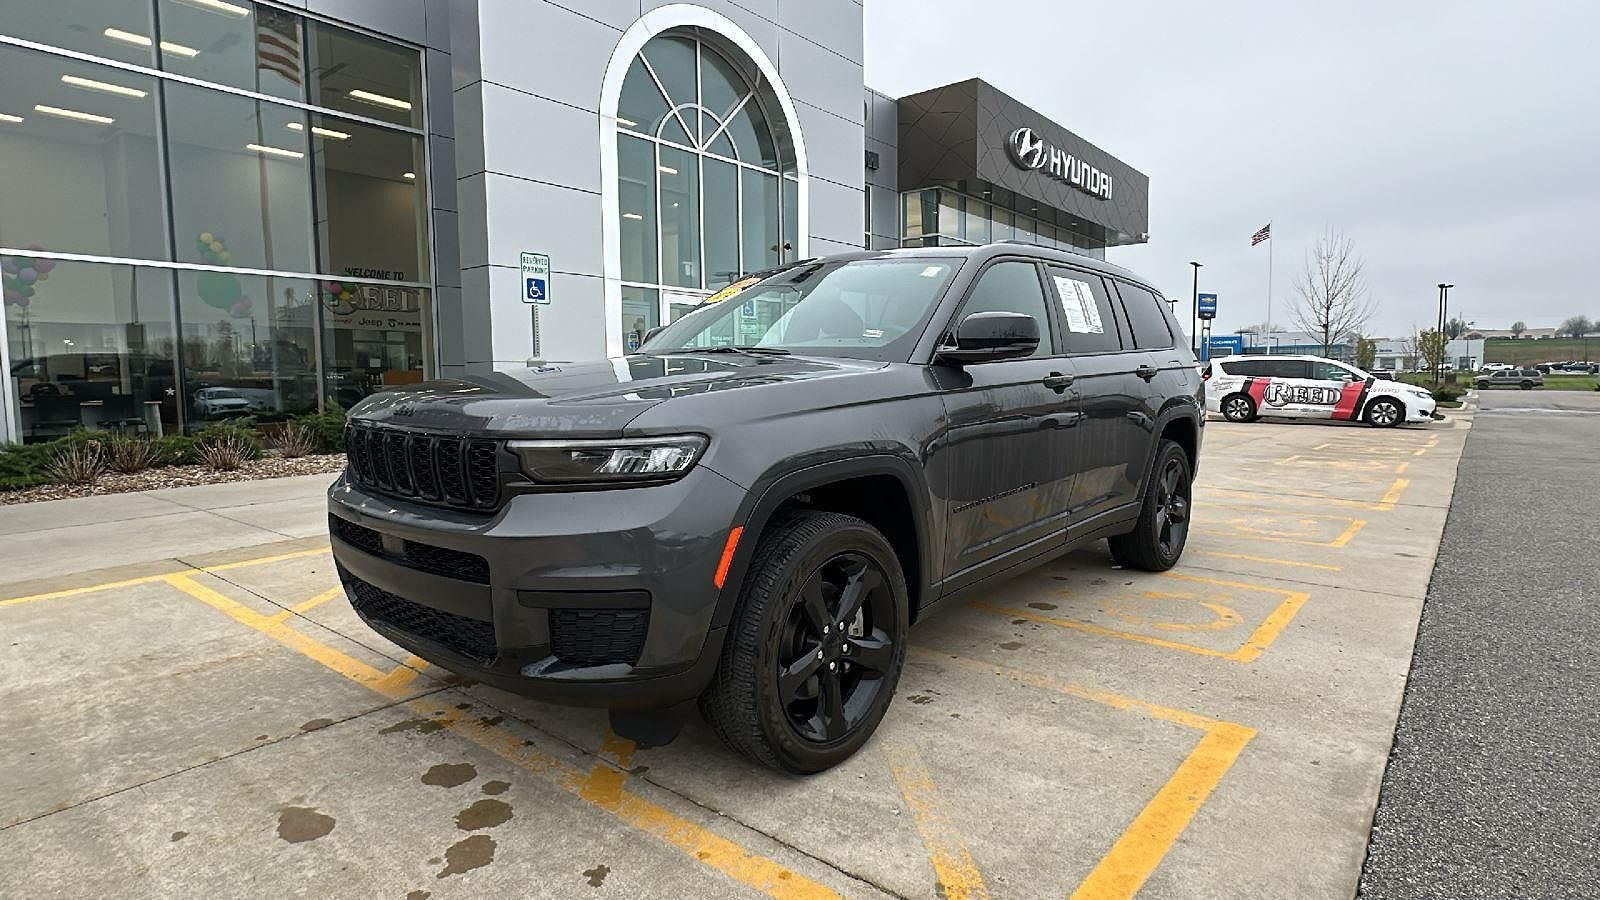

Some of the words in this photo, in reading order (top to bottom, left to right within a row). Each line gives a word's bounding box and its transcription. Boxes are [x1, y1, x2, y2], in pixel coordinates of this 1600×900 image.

[1049, 144, 1112, 200] HYUNDAI
[523, 257, 547, 265] RESERVED
[344, 267, 390, 280] WELCOME
[393, 271, 404, 281] TO
[523, 265, 547, 275] PARKING
[358, 318, 382, 327] Jeep
[1264, 383, 1342, 407] REED
